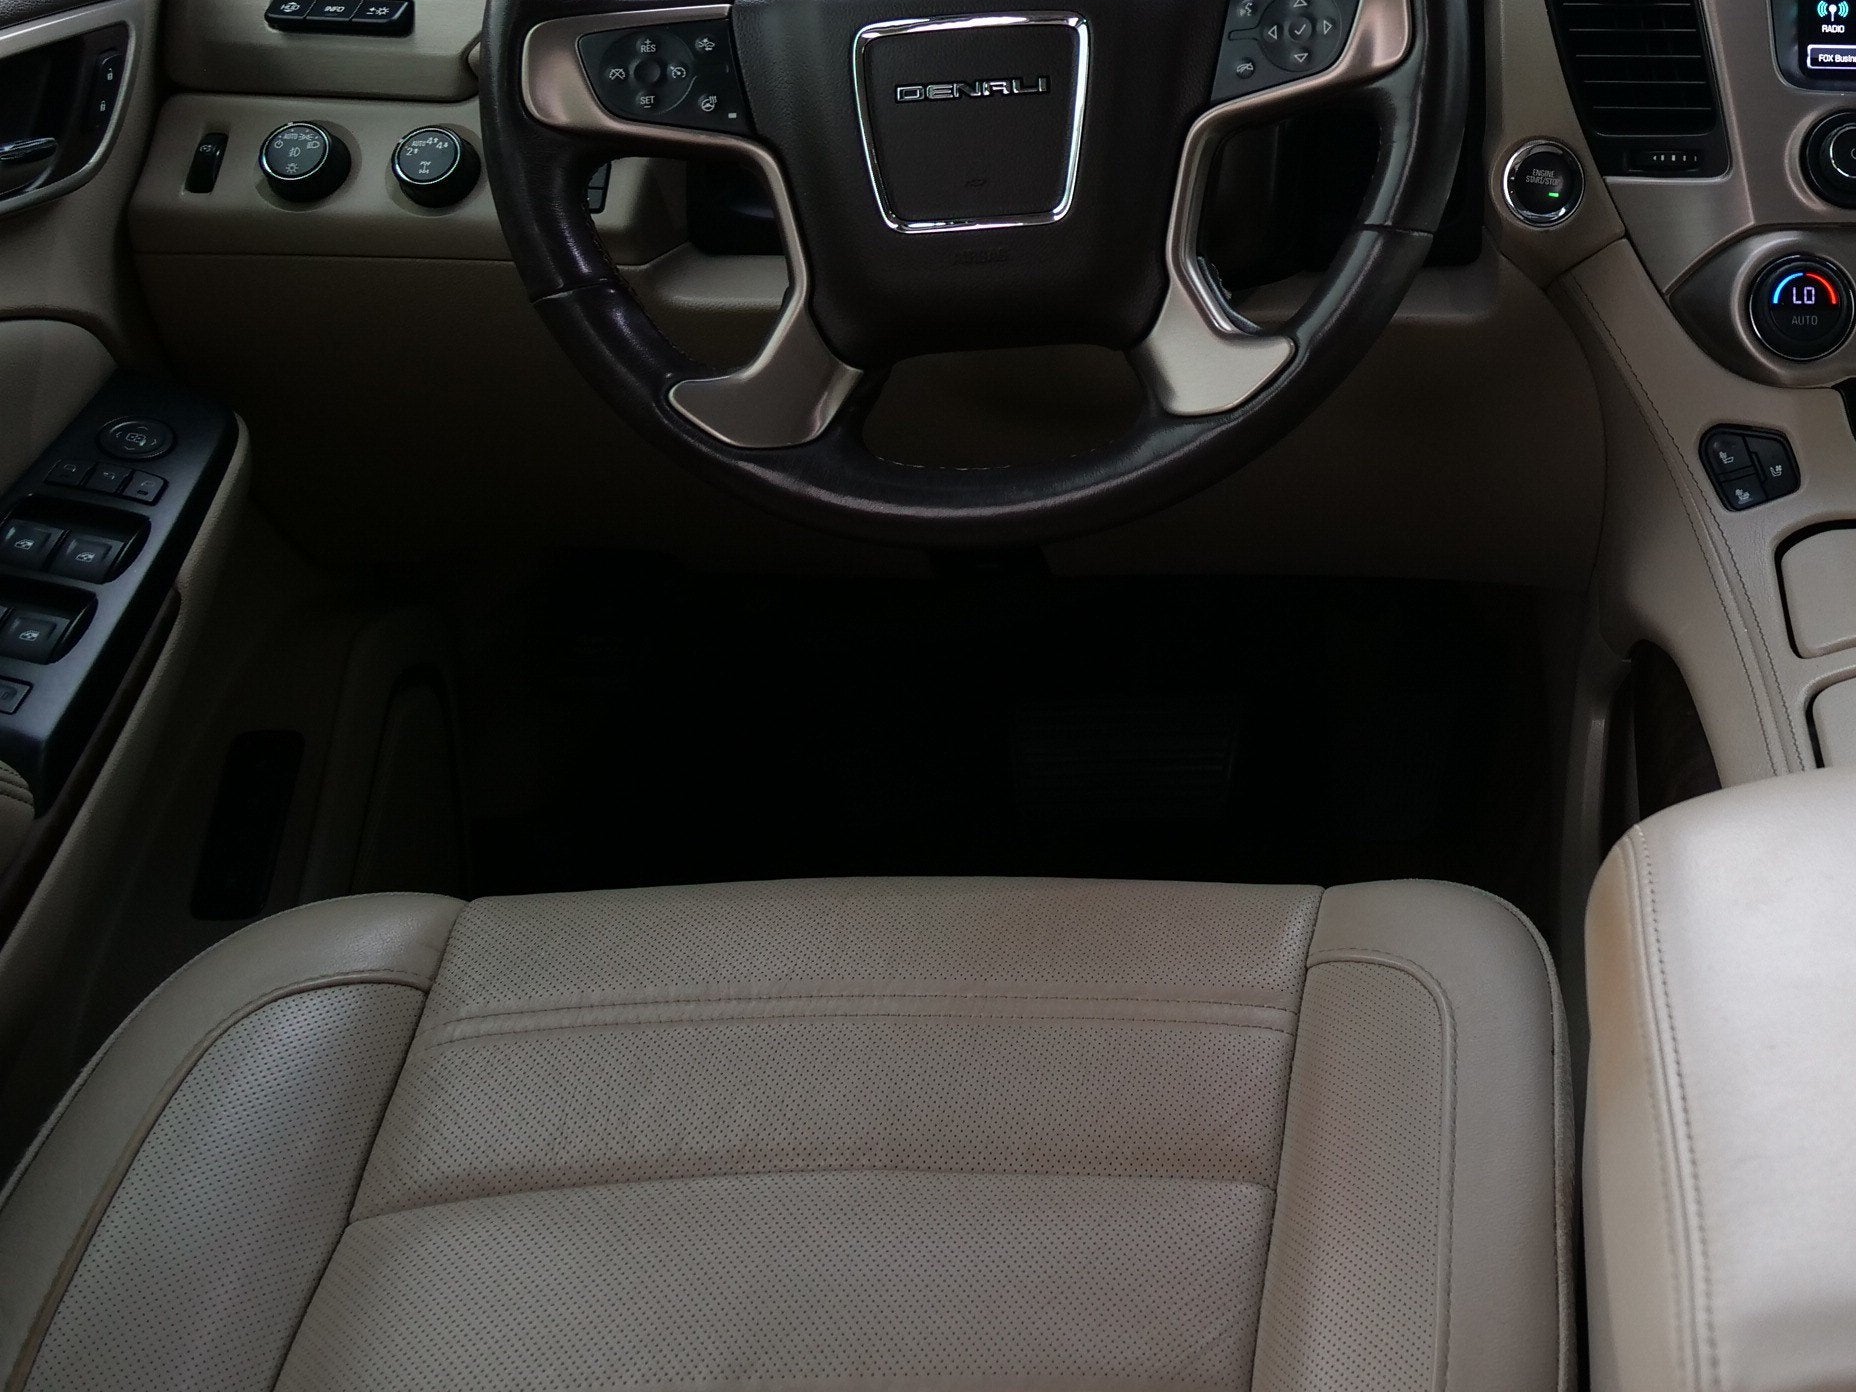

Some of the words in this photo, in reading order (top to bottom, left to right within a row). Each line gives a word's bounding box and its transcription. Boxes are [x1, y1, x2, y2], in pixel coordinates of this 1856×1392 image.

[1822, 24, 1846, 34] RADIO
[640, 44, 656, 52] RES
[1818, 54, 1834, 63] FOX
[896, 77, 1050, 102] DENALI
[640, 96, 655, 104] SET
[1532, 168, 1555, 178] ENGINE
[1792, 286, 1815, 304] LO
[1792, 315, 1818, 326] AUTO
